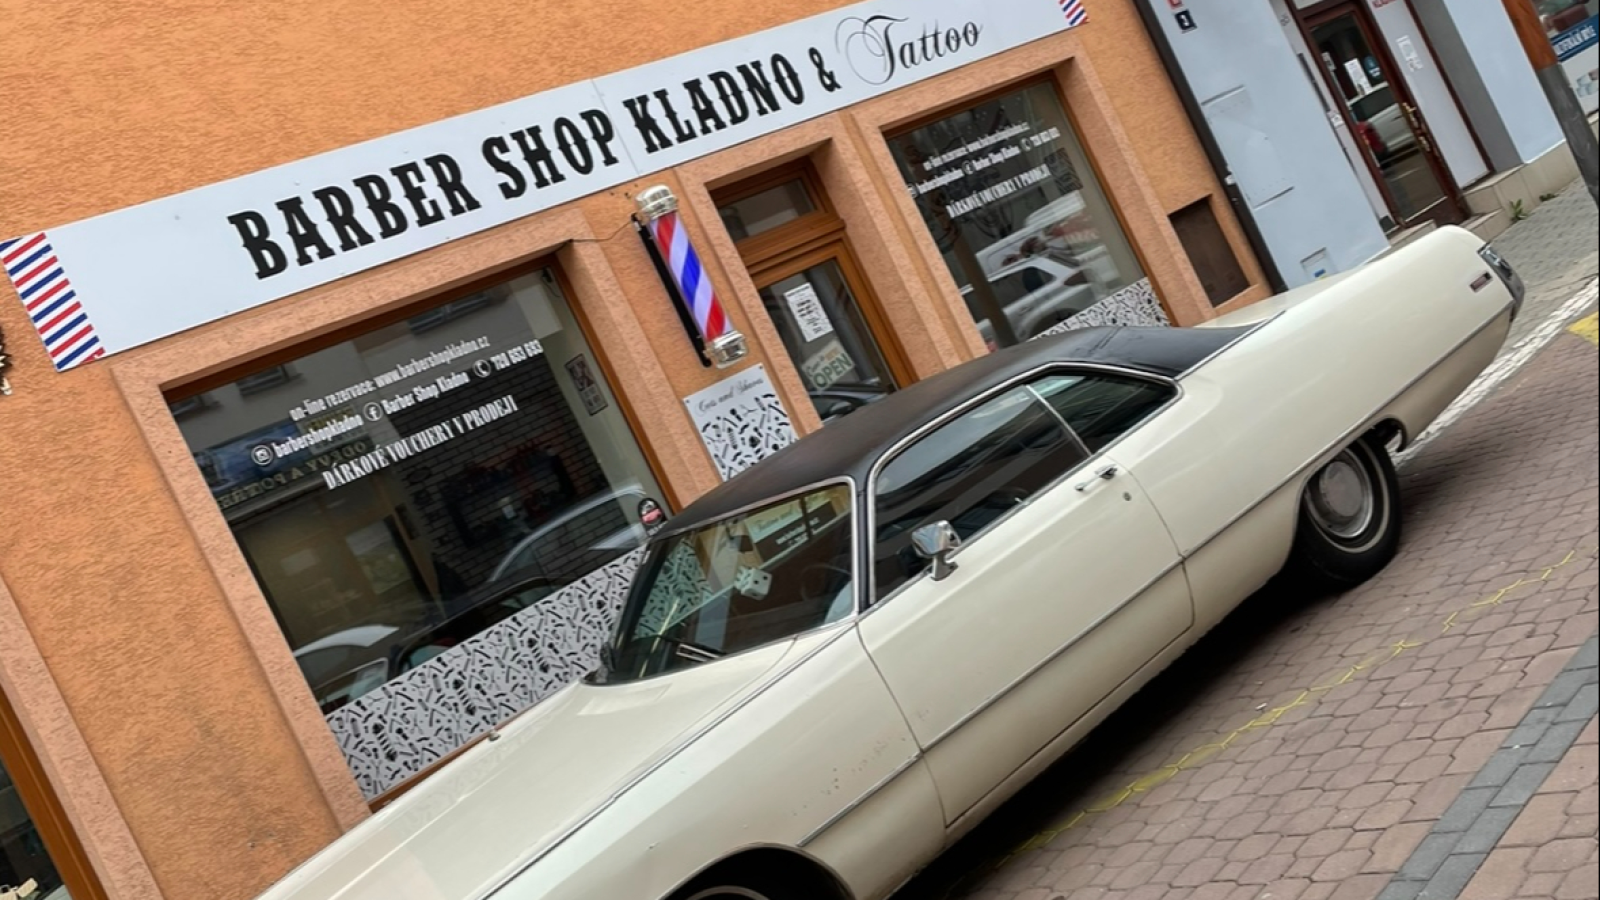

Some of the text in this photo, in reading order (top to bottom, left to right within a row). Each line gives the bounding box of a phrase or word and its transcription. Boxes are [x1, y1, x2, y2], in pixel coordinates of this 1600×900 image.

[227, 14, 983, 280] BARBER SHOP KLADNO & Tattoo
[289, 399, 327, 421] on-line
[325, 380, 377, 408] rezervace:
[373, 335, 490, 388] www.barbershopkladno.cz
[813, 353, 852, 388] OPEN
[271, 414, 364, 458] barbershopkladno
[381, 395, 416, 415] Barber
[412, 383, 440, 402] Shop
[436, 372, 471, 393] Kladno
[322, 394, 519, 490] DÁRKOVÉ VOUCHERY V PRODEJI
